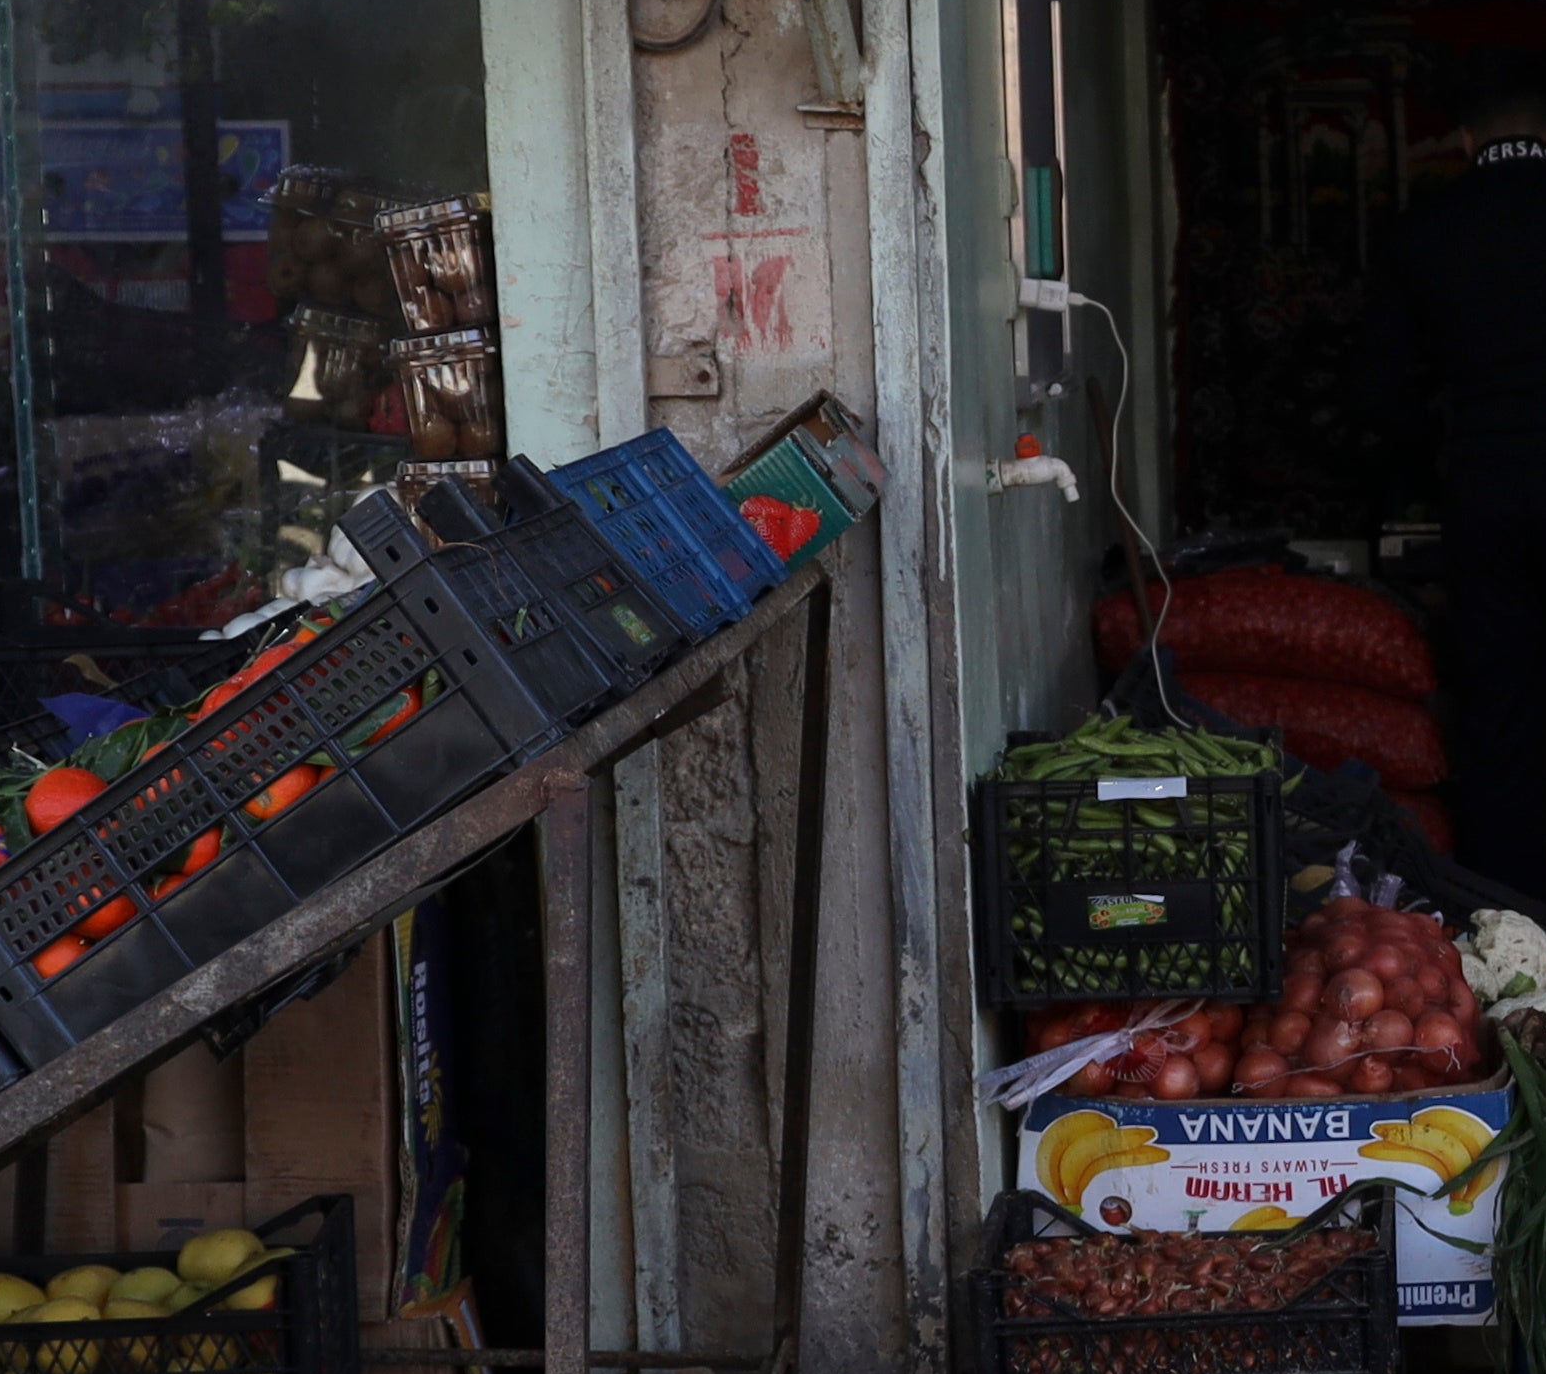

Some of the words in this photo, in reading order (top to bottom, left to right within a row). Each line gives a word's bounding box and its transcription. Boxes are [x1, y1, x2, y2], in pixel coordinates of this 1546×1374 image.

[1177, 1109, 1352, 1143] BANANA
[1198, 1161, 1252, 1176] FRESH
[1260, 1159, 1330, 1174] ALWAYS
